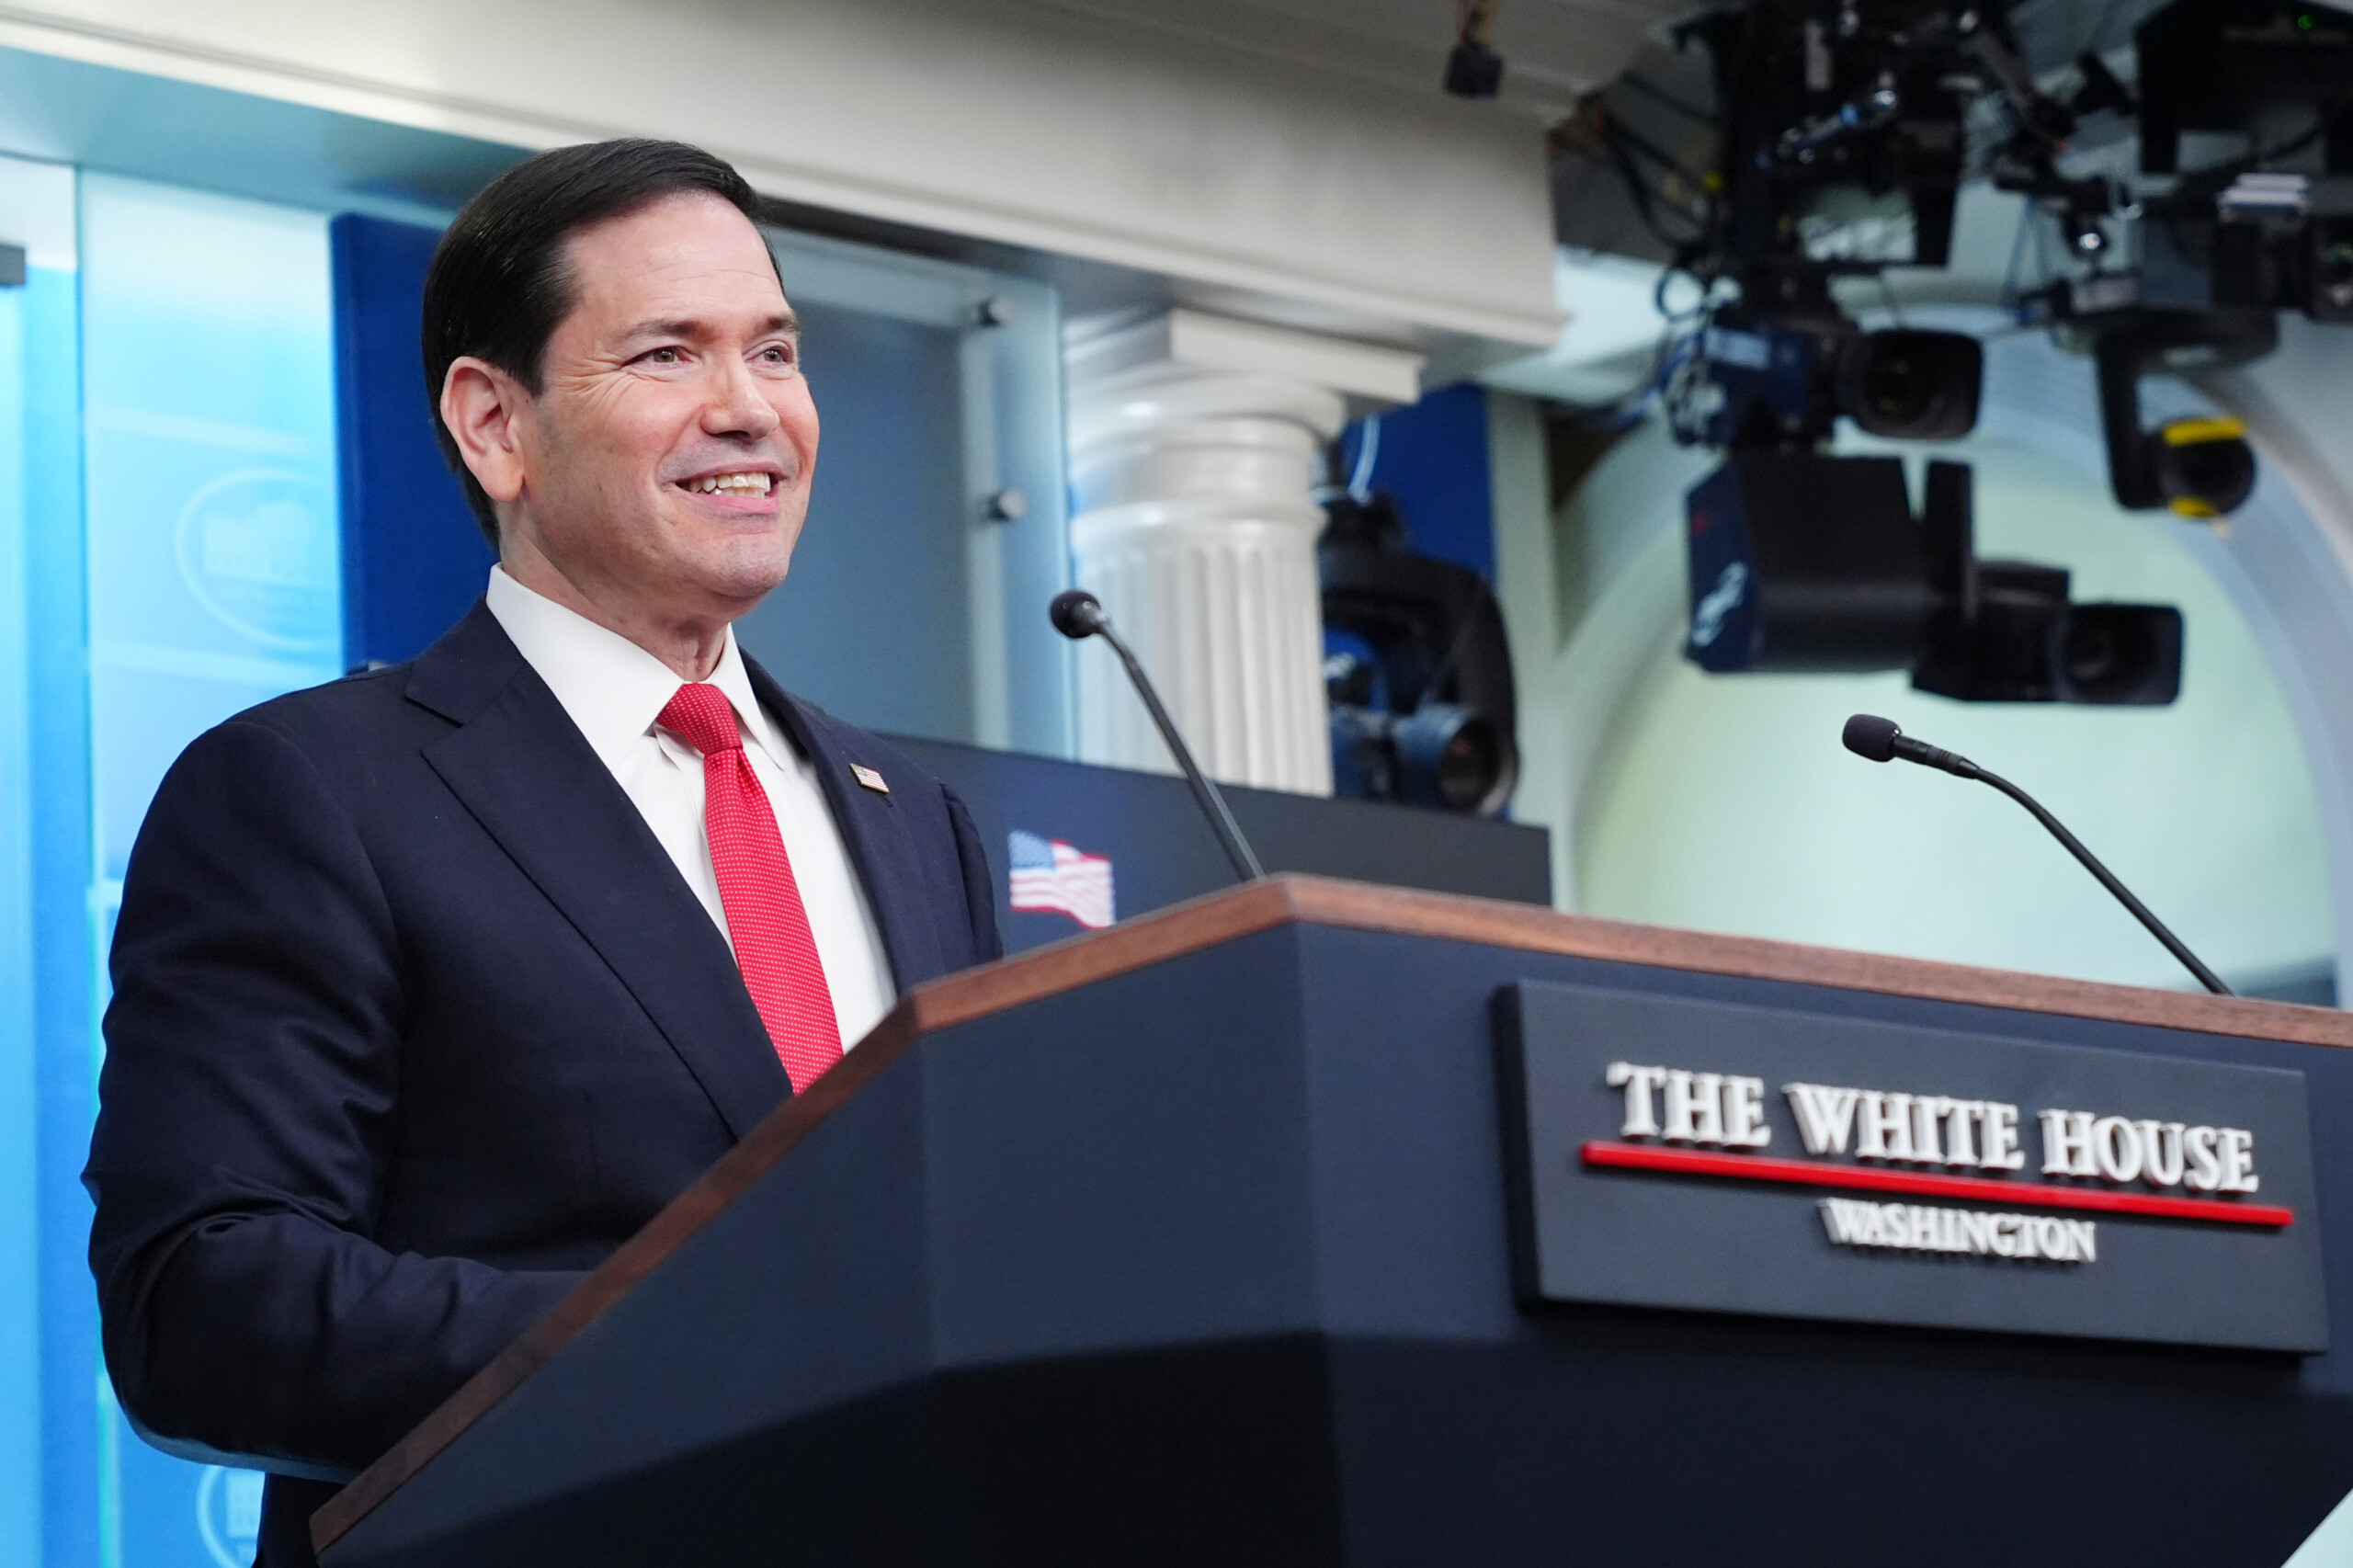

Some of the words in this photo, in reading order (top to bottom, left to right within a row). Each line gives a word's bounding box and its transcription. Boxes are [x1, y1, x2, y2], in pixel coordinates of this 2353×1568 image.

[1606, 1061, 1772, 1148] THE
[1783, 1082, 2026, 1170] WHITE
[2037, 1108, 2260, 1194] HOUSE
[1820, 1197, 2097, 1263] WASHINGTON
